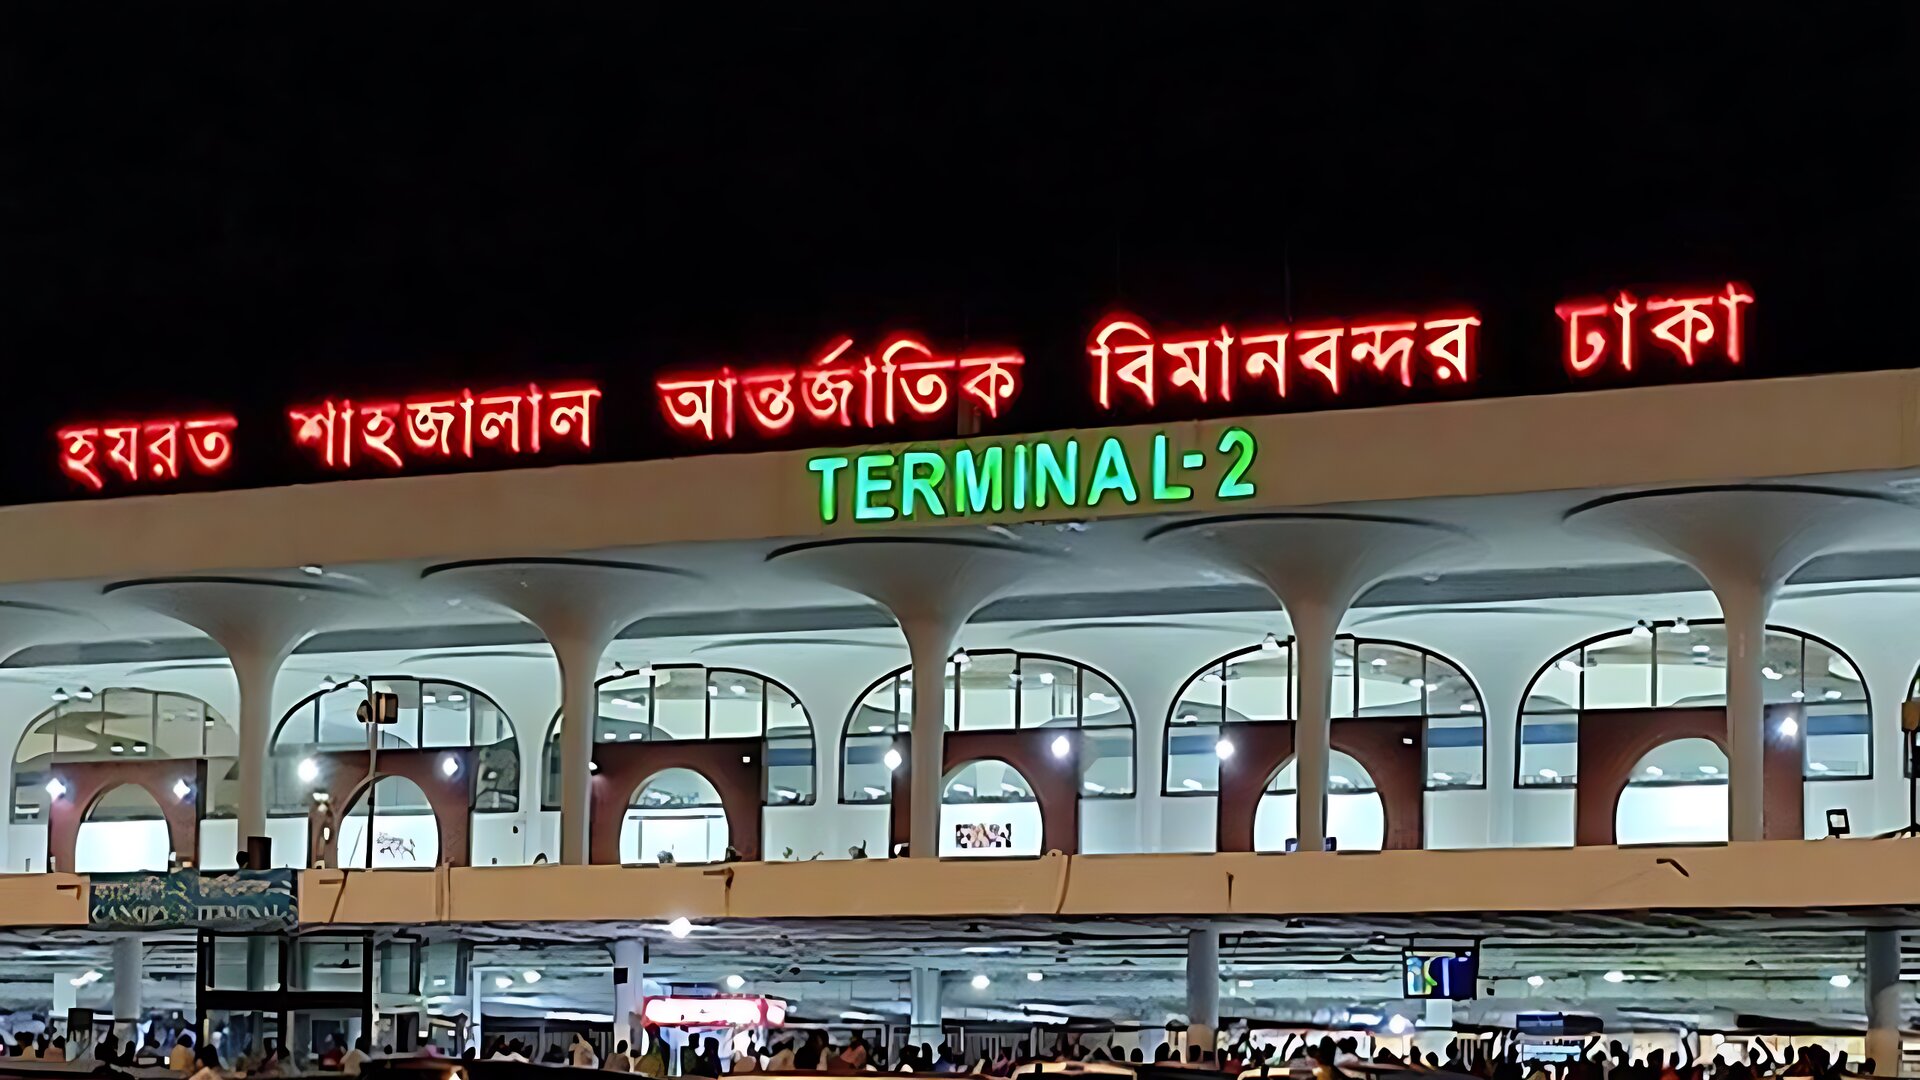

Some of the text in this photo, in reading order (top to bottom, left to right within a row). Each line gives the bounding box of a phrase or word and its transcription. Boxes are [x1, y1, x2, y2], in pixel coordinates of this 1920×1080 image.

[58, 282, 1754, 488] হযরত শাহজালাল আন্তর্জাতিক বিমানবন্দর ঢাকা
[808, 426, 1257, 522] TERMINAL-2
